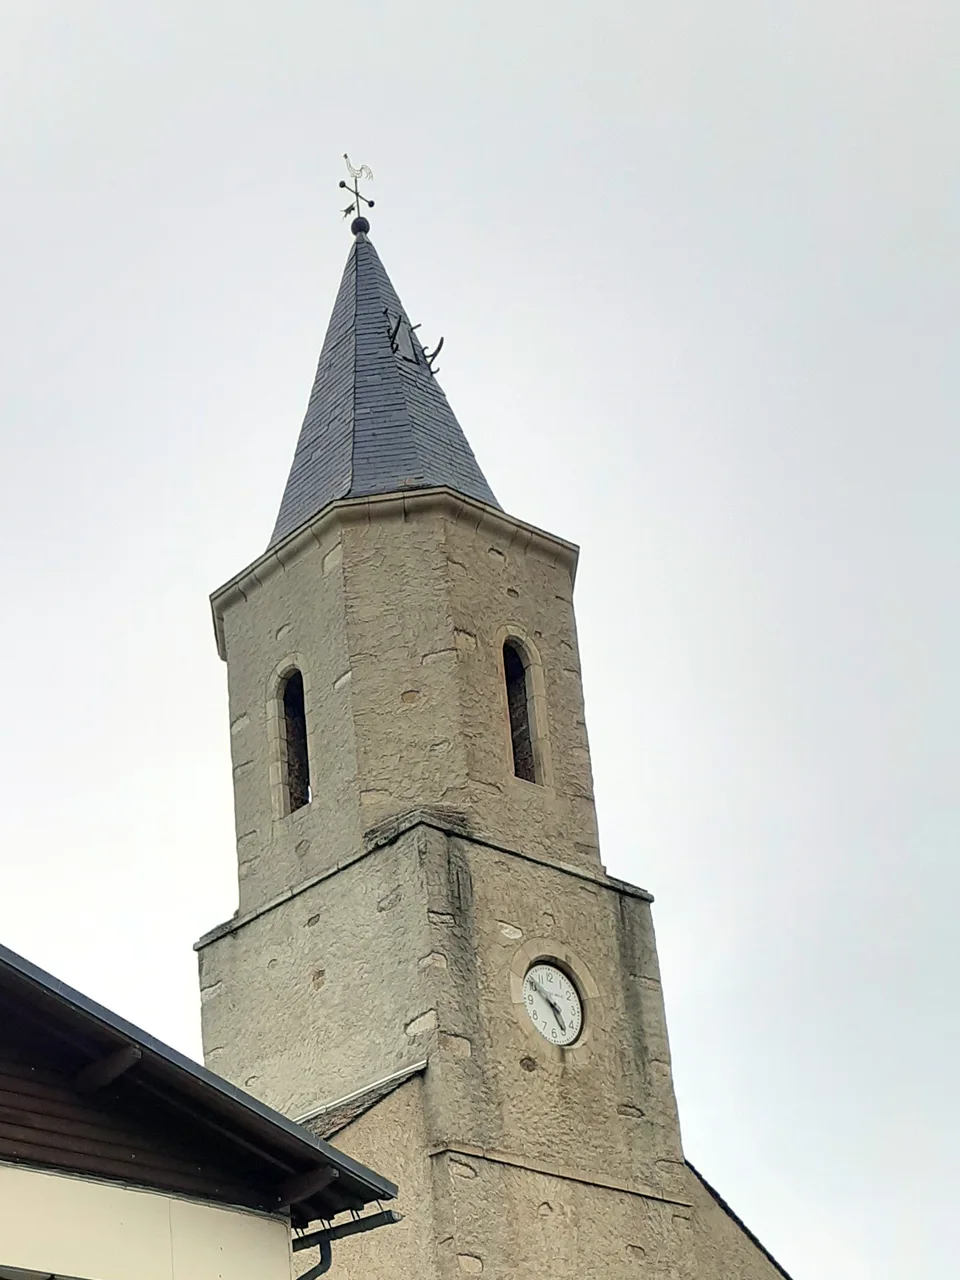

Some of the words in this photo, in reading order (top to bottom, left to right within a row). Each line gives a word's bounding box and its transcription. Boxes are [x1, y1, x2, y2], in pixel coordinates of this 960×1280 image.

[538, 974, 544, 985] 11
[546, 971, 554, 984] 12
[528, 994, 534, 1005] 9
[566, 991, 572, 1001] 2
[532, 1009, 539, 1021] 8
[571, 1006, 577, 1016] 3
[542, 1021, 548, 1031] 7
[569, 1020, 575, 1030] 4
[551, 1028, 558, 1039] 6
